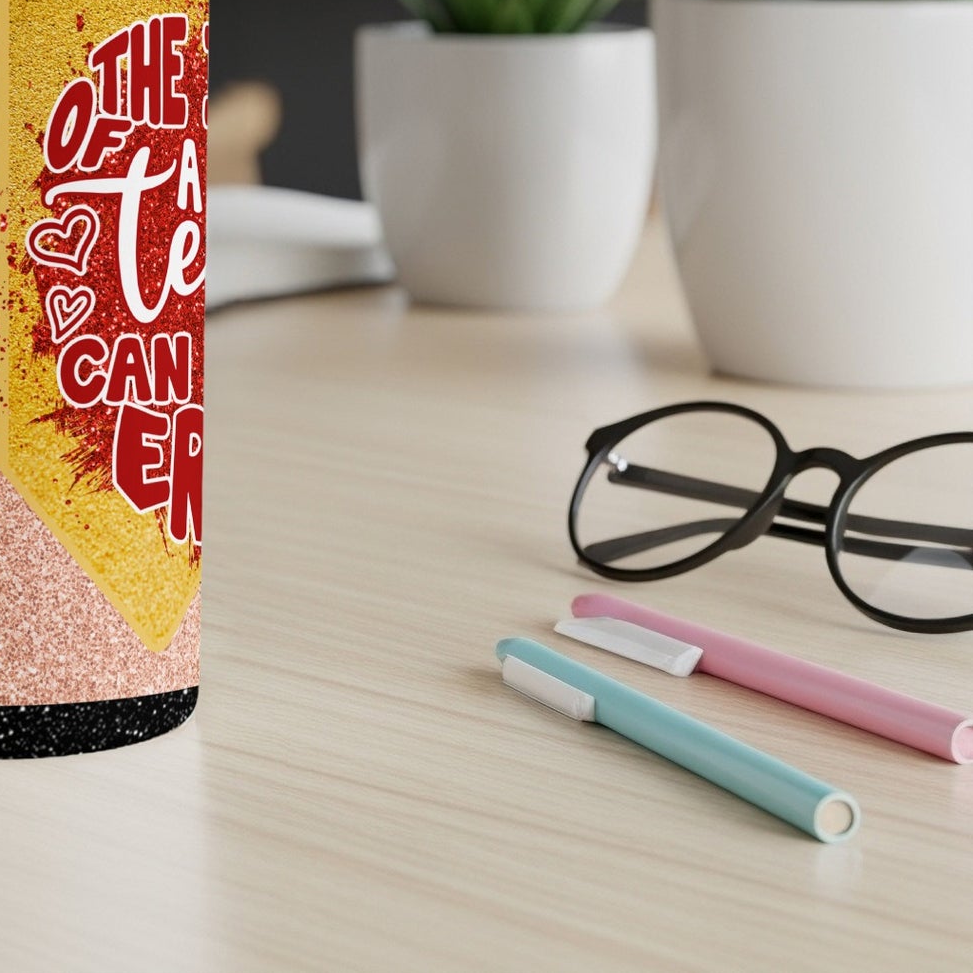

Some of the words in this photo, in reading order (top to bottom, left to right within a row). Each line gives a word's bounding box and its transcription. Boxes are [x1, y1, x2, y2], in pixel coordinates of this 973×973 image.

[88, 13, 189, 129] THE
[44, 77, 132, 173] OF
[177, 138, 203, 213] A
[57, 331, 192, 408] CAN
[112, 403, 204, 546] ER
